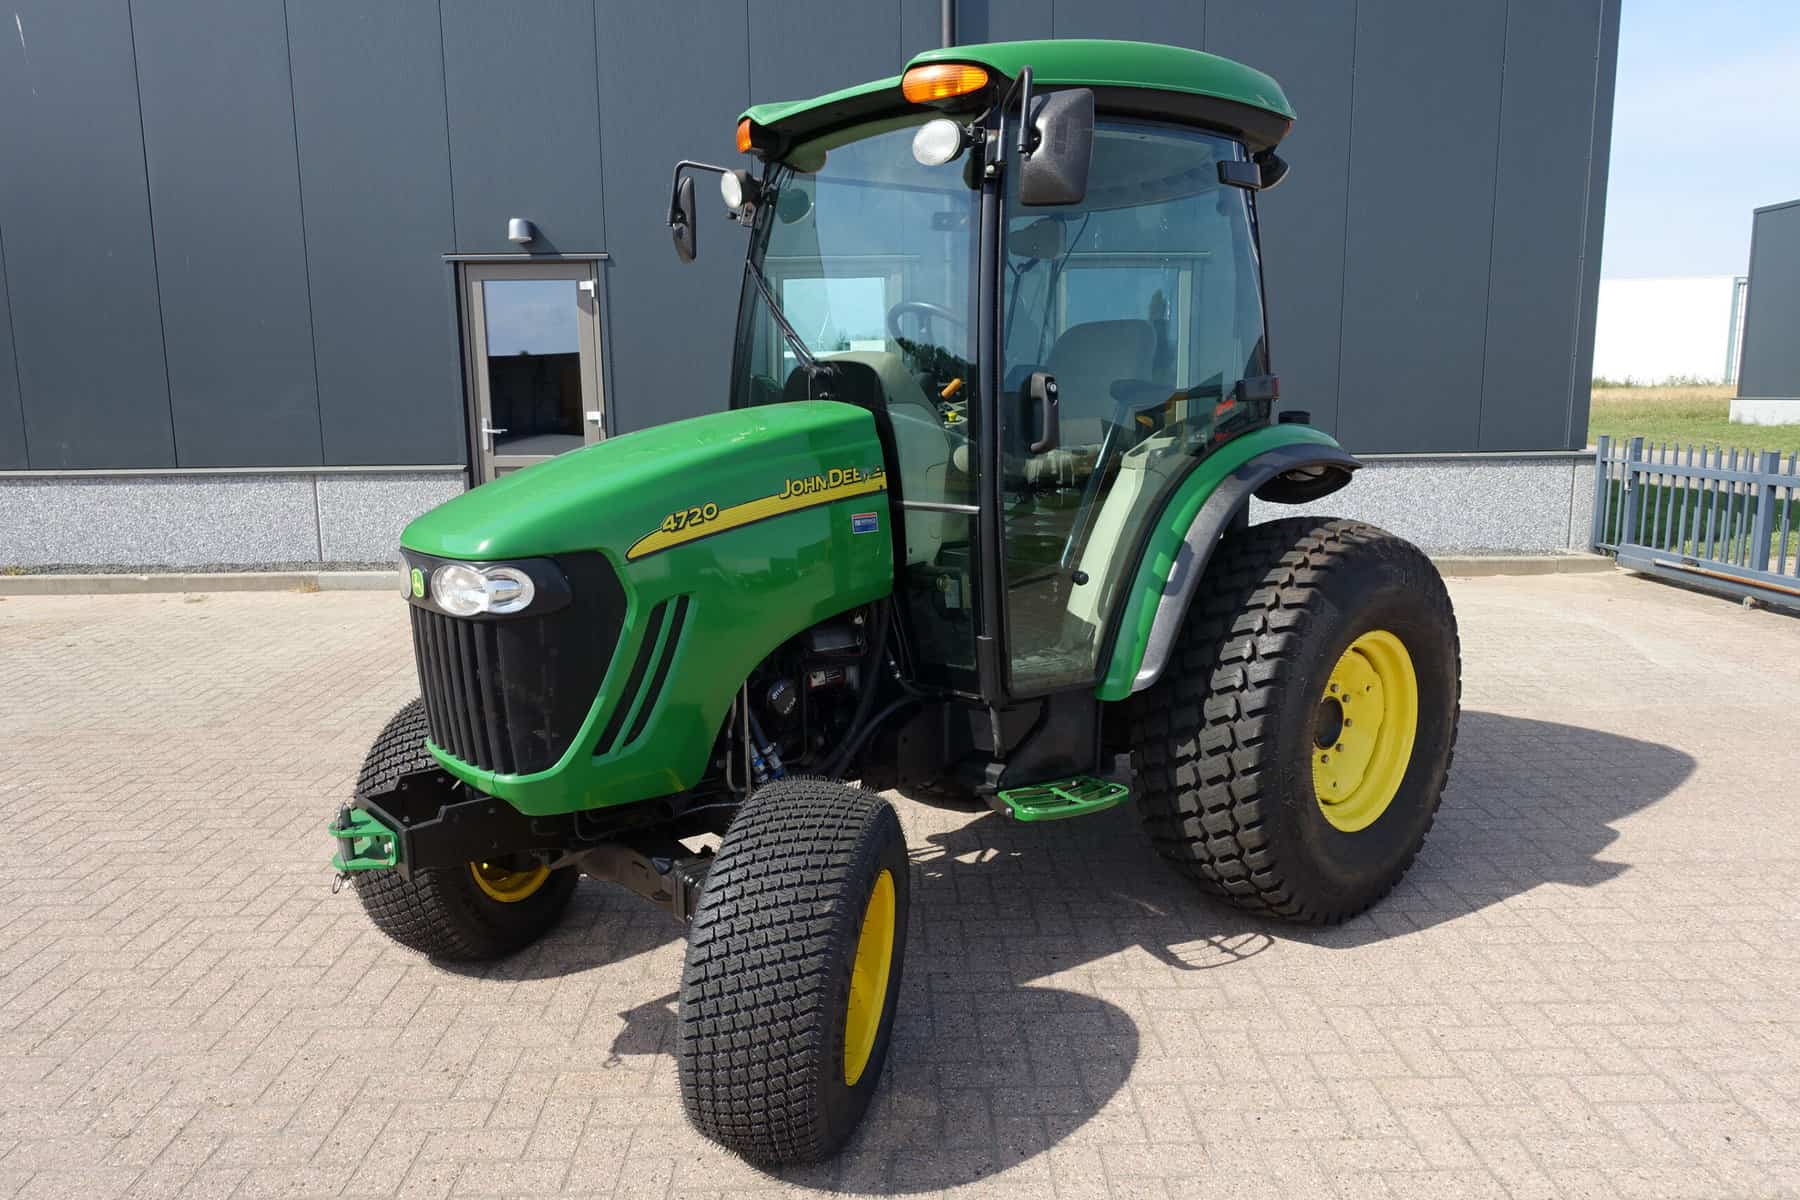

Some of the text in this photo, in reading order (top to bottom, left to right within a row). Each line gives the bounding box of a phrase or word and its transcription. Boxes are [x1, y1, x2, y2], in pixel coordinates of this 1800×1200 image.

[780, 467, 882, 499] JOHN DEE
[662, 502, 719, 531] 4720
